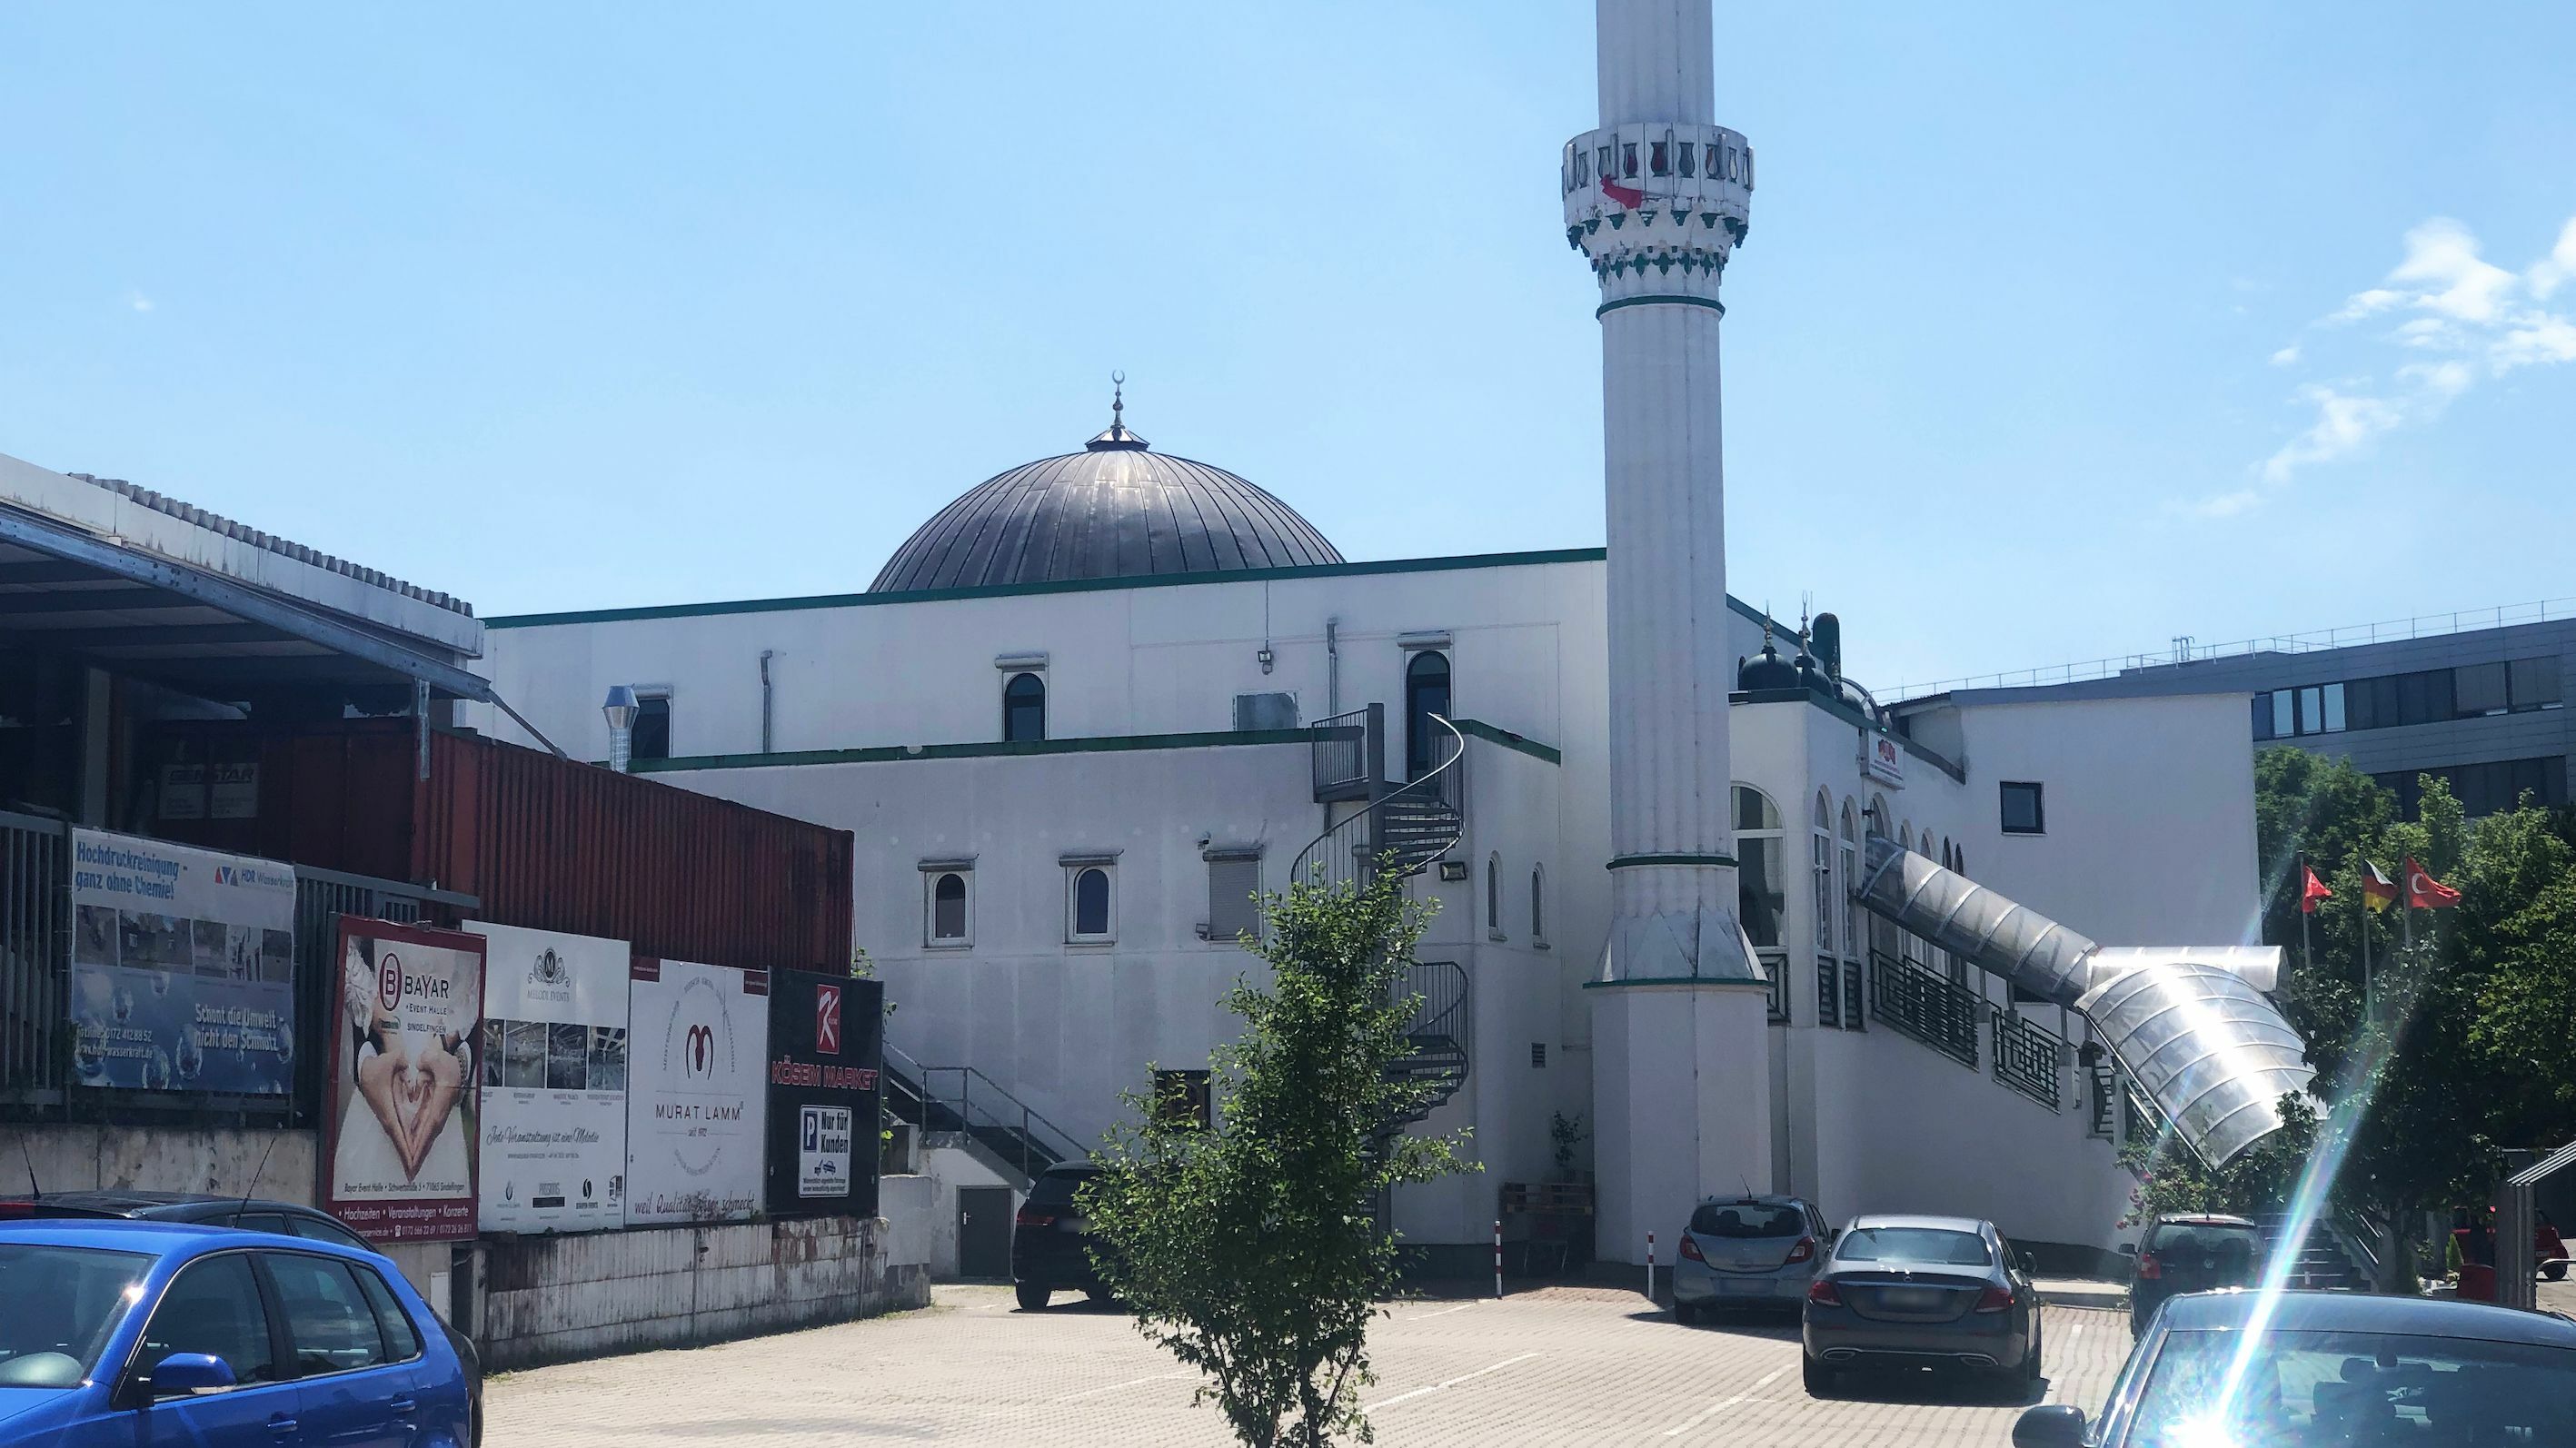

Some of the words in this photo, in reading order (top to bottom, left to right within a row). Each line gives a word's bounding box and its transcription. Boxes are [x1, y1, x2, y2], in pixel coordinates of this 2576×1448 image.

[77, 841, 180, 880] Hochdruckreinigung
[75, 870, 103, 892] ganz
[106, 871, 133, 893] ohne
[135, 874, 175, 900] Chemie!
[241, 868, 256, 883] HDR
[404, 975, 449, 999] BAYAR
[195, 1003, 226, 1024] Schont
[228, 1006, 242, 1025] die
[244, 1007, 277, 1029] Umwelt
[194, 1026, 220, 1048] nicht
[222, 1027, 239, 1049] den
[407, 1022, 447, 1034] SINDELFINGEN
[771, 1055, 821, 1087] KÖSEM
[823, 1065, 879, 1090] MARKET
[655, 1104, 700, 1120] MURAT
[705, 1106, 741, 1121] LAMM
[821, 1111, 835, 1130] Nur
[837, 1111, 849, 1131] für
[821, 1134, 849, 1154] Kunden
[343, 1205, 381, 1221] Hochzeiten
[388, 1204, 437, 1221] Veranstaltungen
[443, 1204, 470, 1218] Konzerte
[634, 1191, 653, 1215] weil
[721, 1190, 754, 1214] schmeckt
